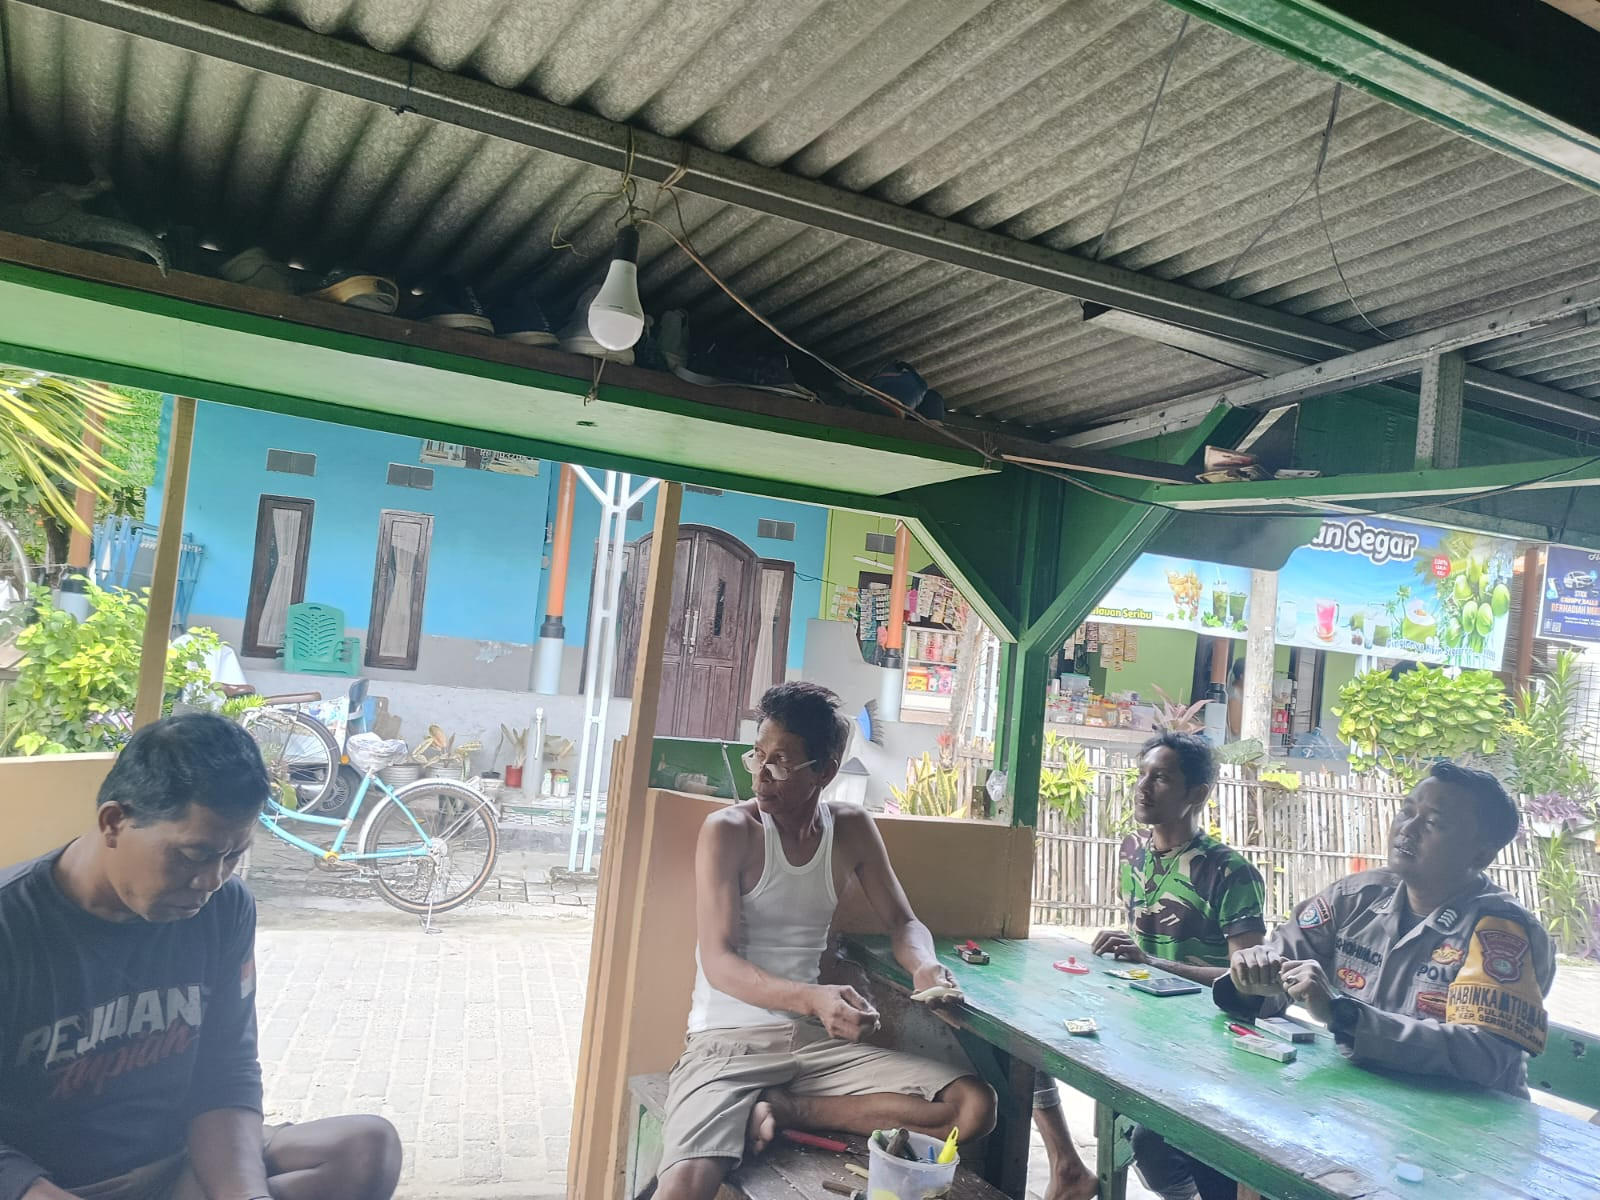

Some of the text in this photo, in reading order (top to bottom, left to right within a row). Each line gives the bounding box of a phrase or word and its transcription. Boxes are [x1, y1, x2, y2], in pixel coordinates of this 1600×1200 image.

[1346, 521, 1418, 563] Segar
[1122, 608, 1152, 620] Seribu
[16, 985, 203, 1069] PEJUAN
